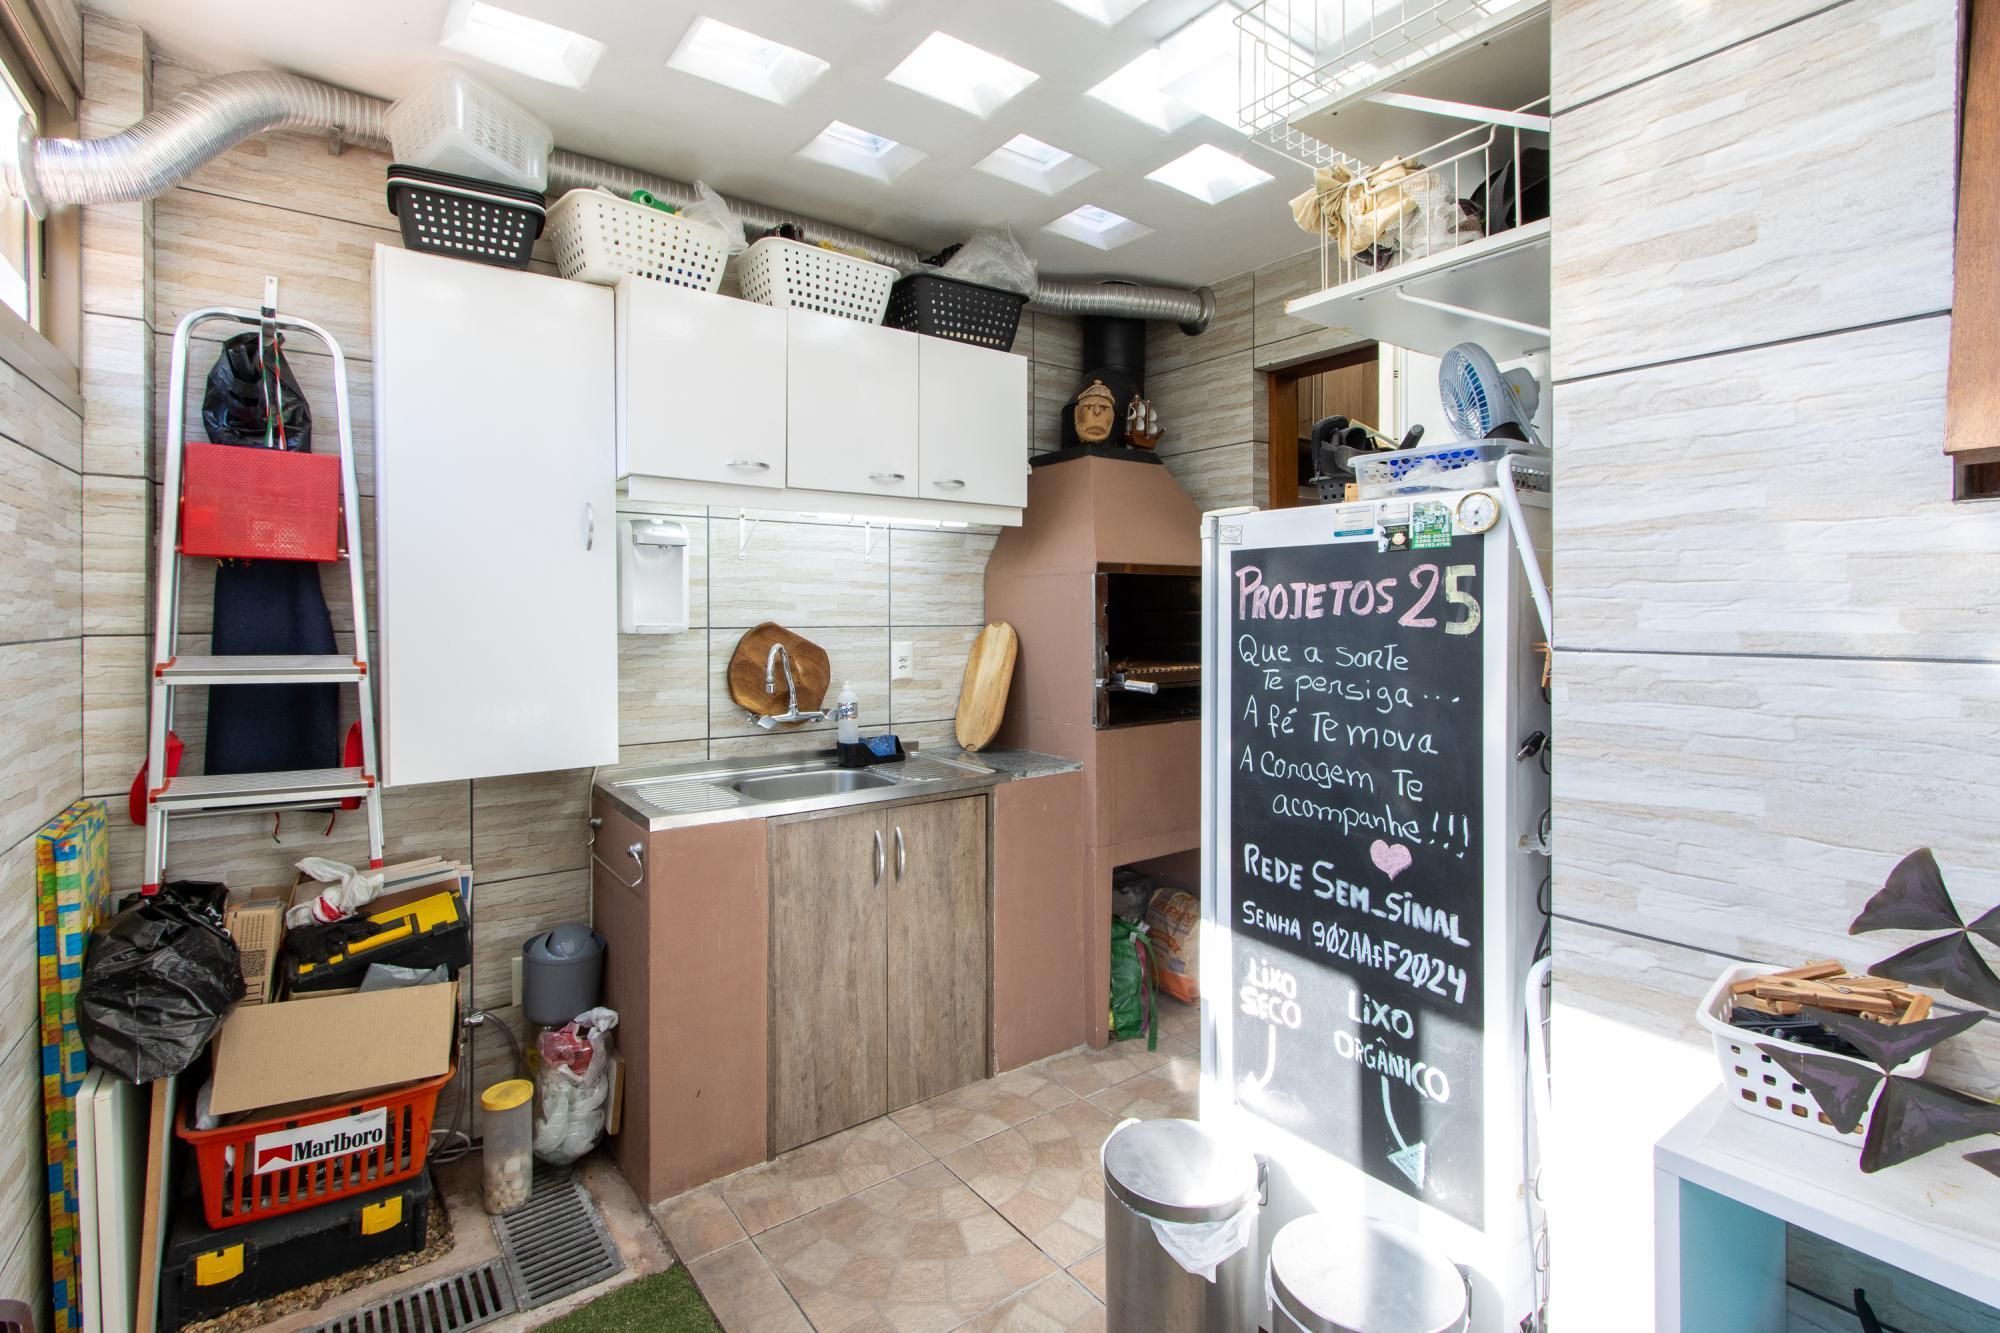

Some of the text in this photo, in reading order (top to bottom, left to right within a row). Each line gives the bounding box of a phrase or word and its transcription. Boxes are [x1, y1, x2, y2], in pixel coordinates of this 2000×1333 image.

[1235, 563, 1481, 635] PROJETOS 25
[1239, 634, 1291, 667] Que
[1304, 647, 1323, 663] a
[1262, 669, 1283, 690] Te
[1243, 695, 1439, 755] A fé Te mova
[1240, 744, 1253, 772] A
[1392, 769, 1423, 802] Te
[1244, 843, 1304, 891] REDE
[1242, 900, 1302, 941] SENHA
[1240, 985, 1301, 1029] SECO
[1334, 1030, 1450, 1103] ORGÂNICO
[294, 1127, 383, 1161] Marlboro
